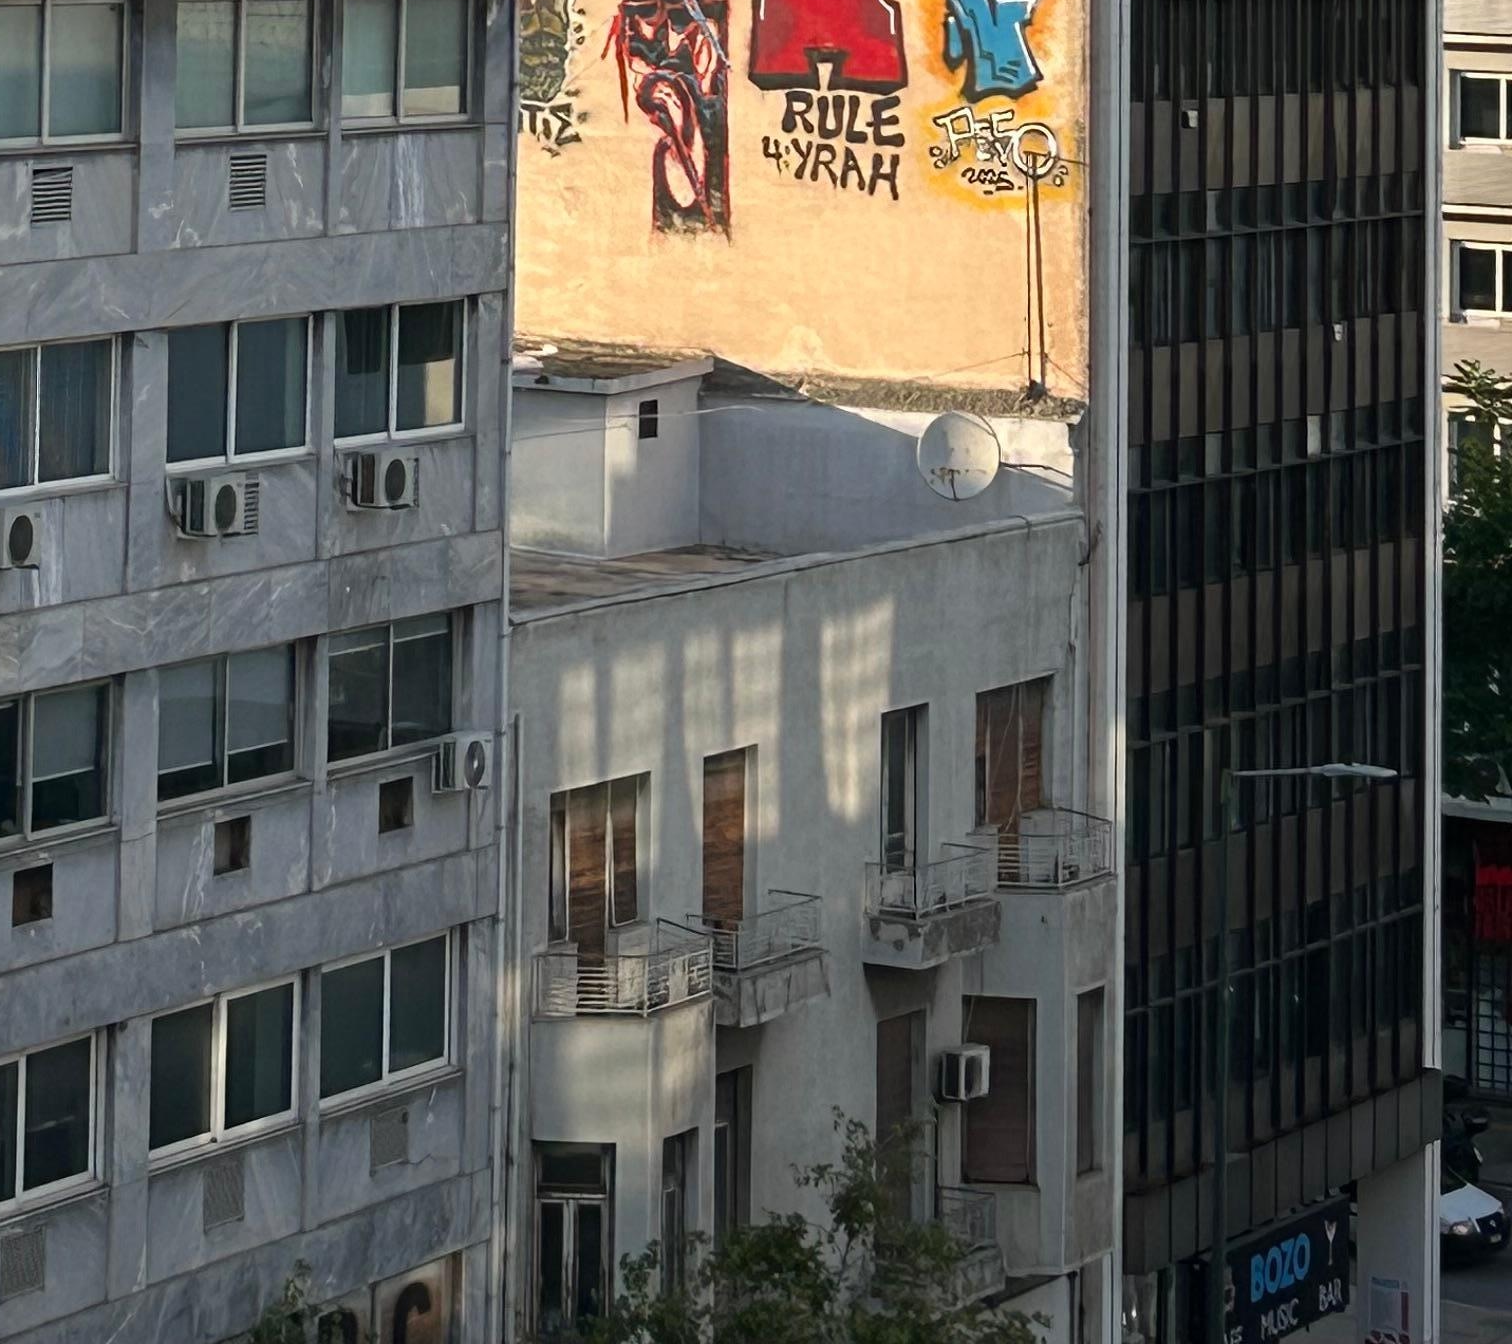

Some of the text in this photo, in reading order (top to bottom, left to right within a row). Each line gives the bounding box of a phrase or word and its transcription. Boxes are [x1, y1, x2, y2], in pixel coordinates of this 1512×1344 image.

[782, 90, 905, 147] RULE
[791, 138, 900, 201] YRAH
[1249, 1232, 1311, 1303] BOZO
[1319, 1277, 1344, 1312] BAR
